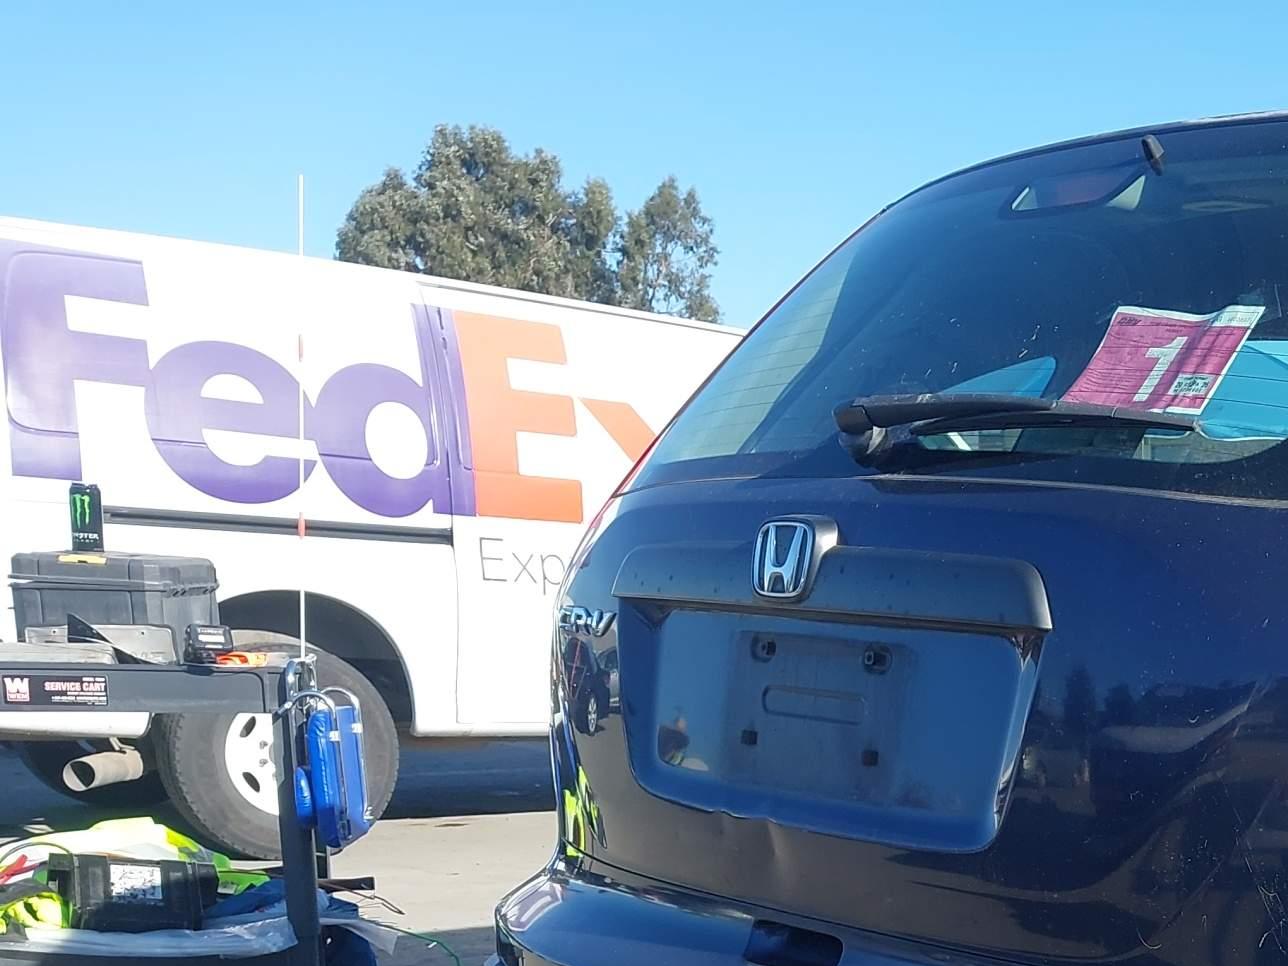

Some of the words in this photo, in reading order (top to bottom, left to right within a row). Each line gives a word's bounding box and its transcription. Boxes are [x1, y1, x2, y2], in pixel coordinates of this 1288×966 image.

[1133, 336, 1188, 402] 1
[44, 681, 81, 691] SERVICE
[82, 682, 105, 692] CART
